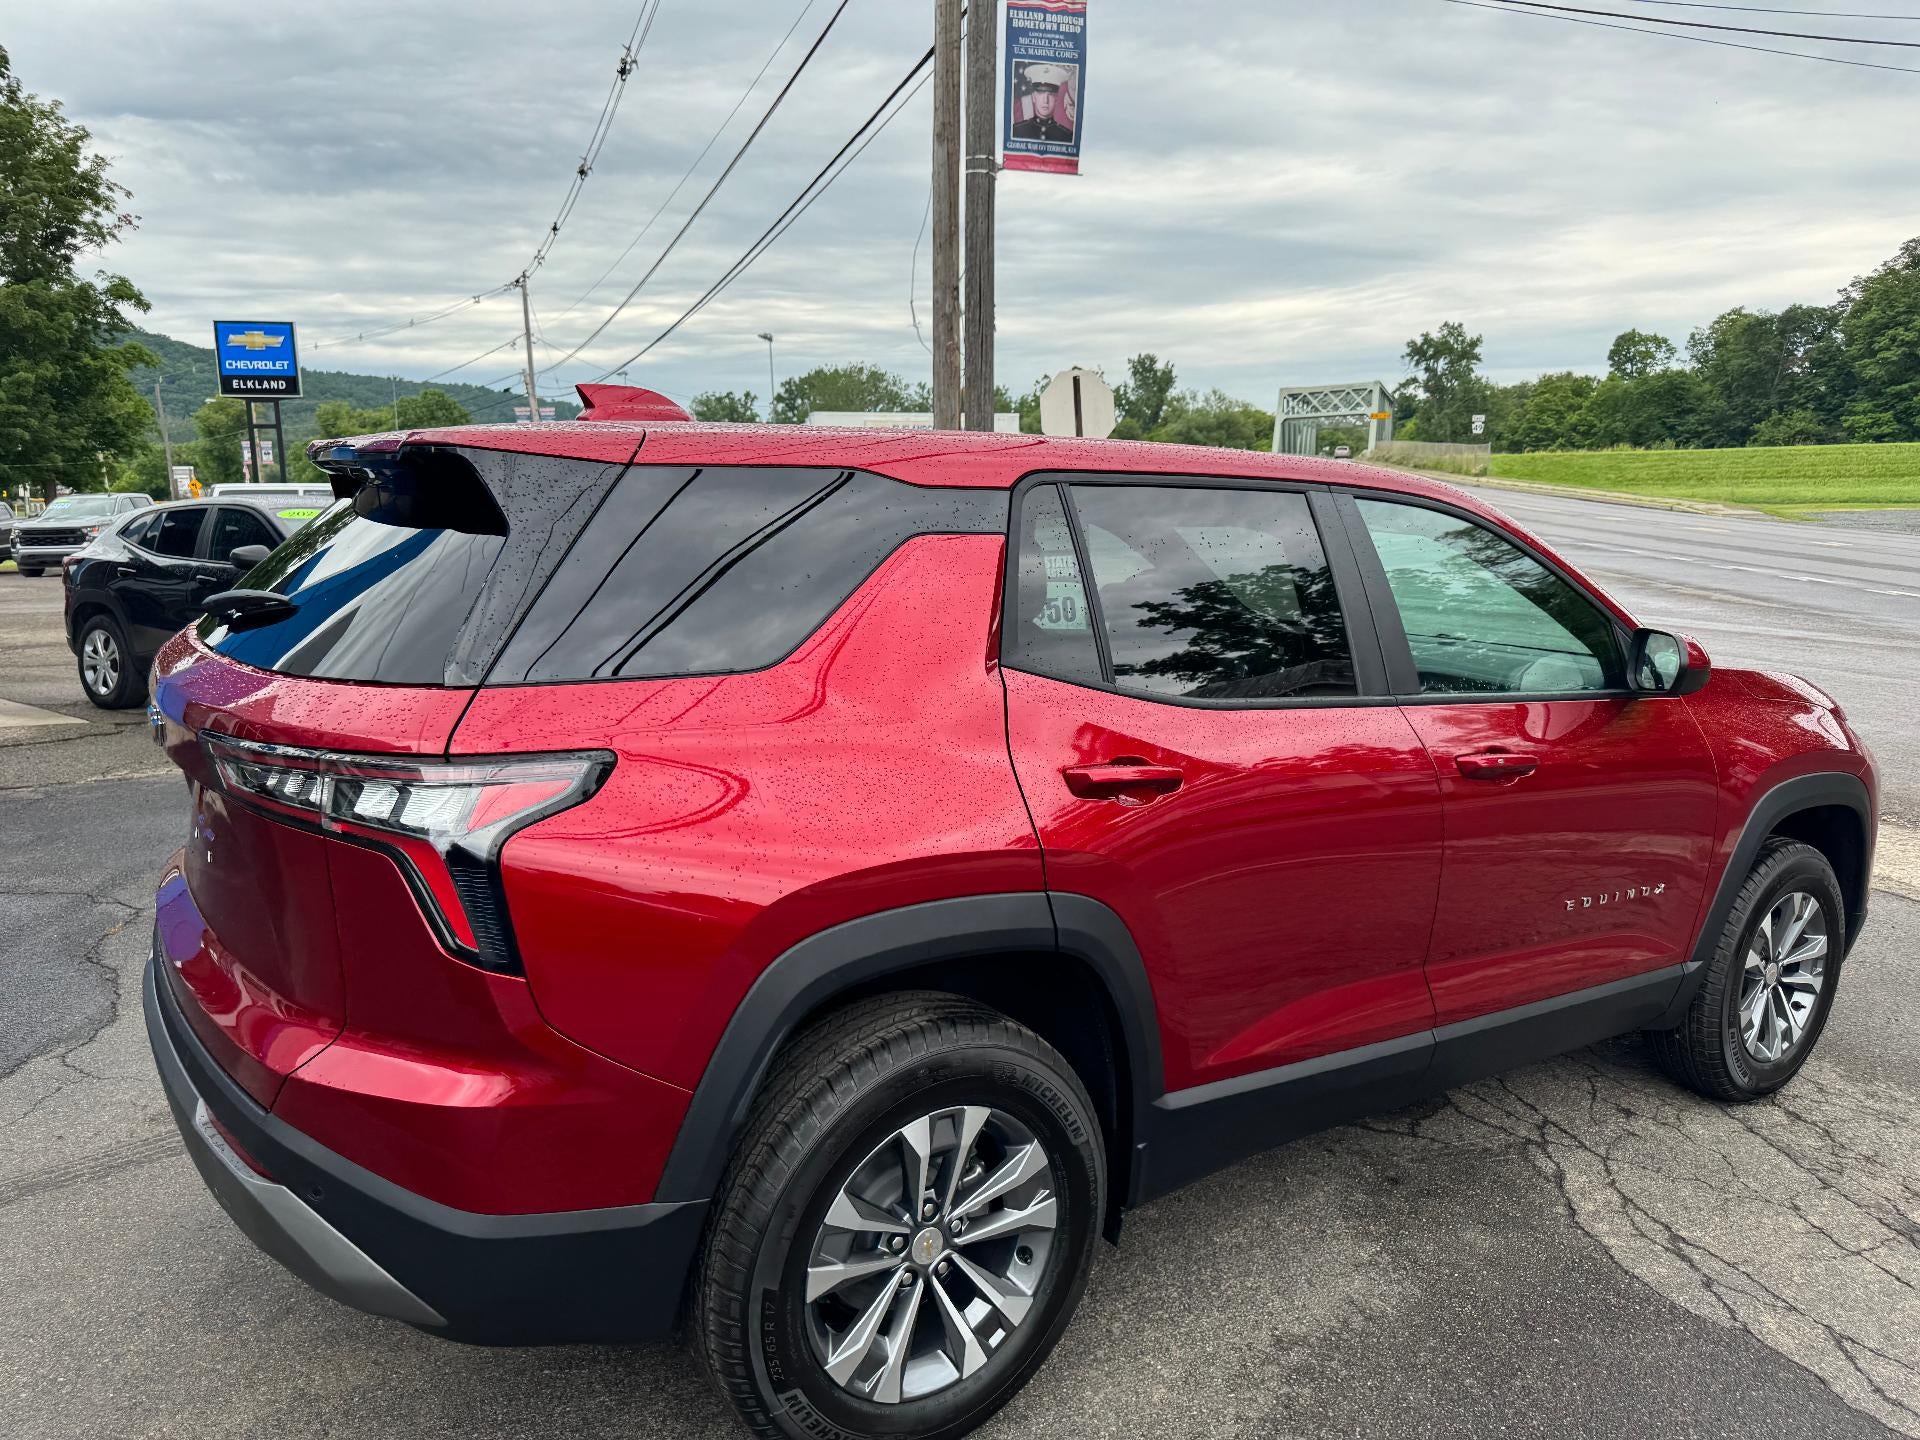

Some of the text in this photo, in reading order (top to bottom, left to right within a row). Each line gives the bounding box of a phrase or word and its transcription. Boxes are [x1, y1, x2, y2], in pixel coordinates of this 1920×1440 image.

[1009, 9, 1084, 26] ELKLAND BOROUGH
[1012, 18, 1081, 34] HOMETOWN HERO
[1018, 36, 1075, 49] MICHAEL PLANK
[1013, 46, 1079, 59] U.S. MARINE CORPS
[1006, 141, 1028, 150] GLOBAL
[225, 360, 289, 370] CHEVROLET
[232, 379, 287, 390] ELKLAND
[1564, 882, 1666, 912] EQUINOX
[1729, 1030, 1750, 1079] MICHELIN
[1020, 1073, 1085, 1141] MICHELIN
